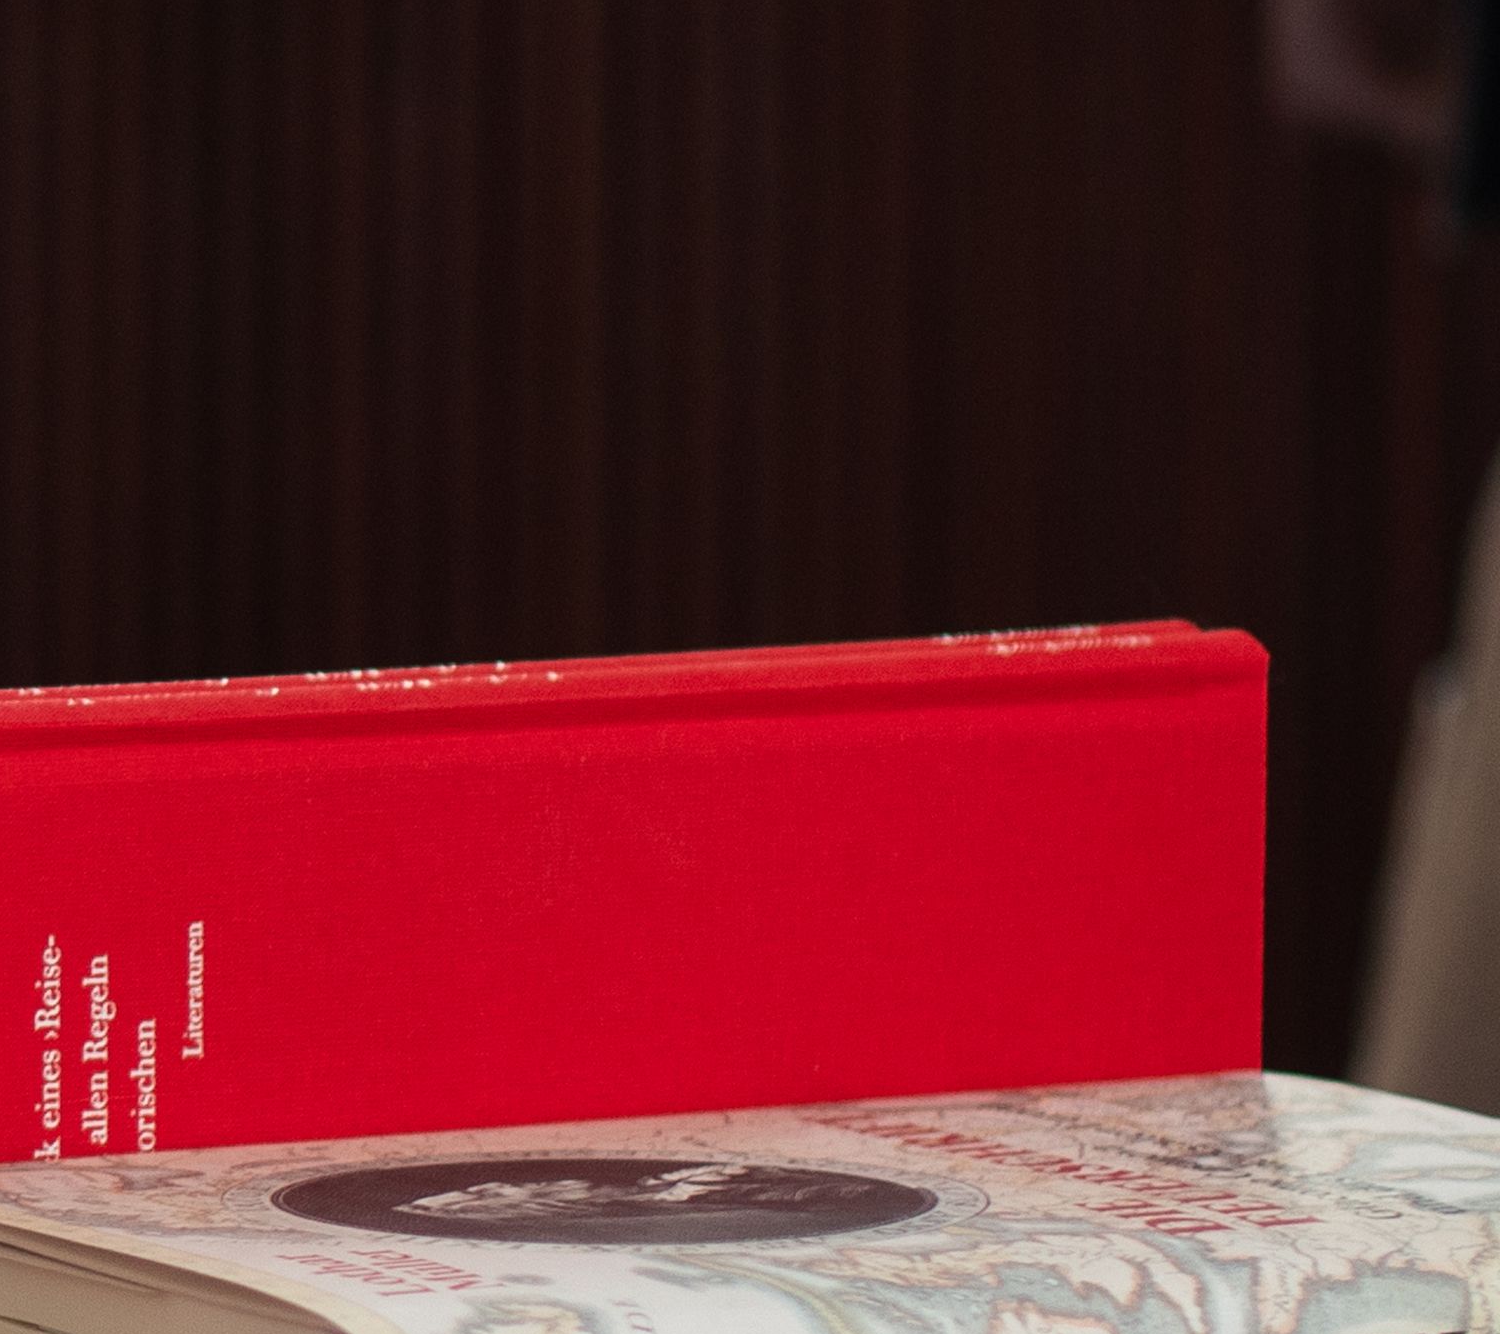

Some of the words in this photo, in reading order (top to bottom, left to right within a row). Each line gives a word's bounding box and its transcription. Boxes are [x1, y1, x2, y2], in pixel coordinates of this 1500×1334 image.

[82, 953, 117, 1063] Regeln
[182, 920, 204, 1060] Literaturen
[34, 1049, 61, 1130] eines
[82, 1070, 109, 1146] allen
[129, 1018, 156, 1152] orischen
[1074, 1198, 1235, 1236] DIE
[275, 1253, 436, 1297] Lothar
[348, 1249, 506, 1291] Müller
